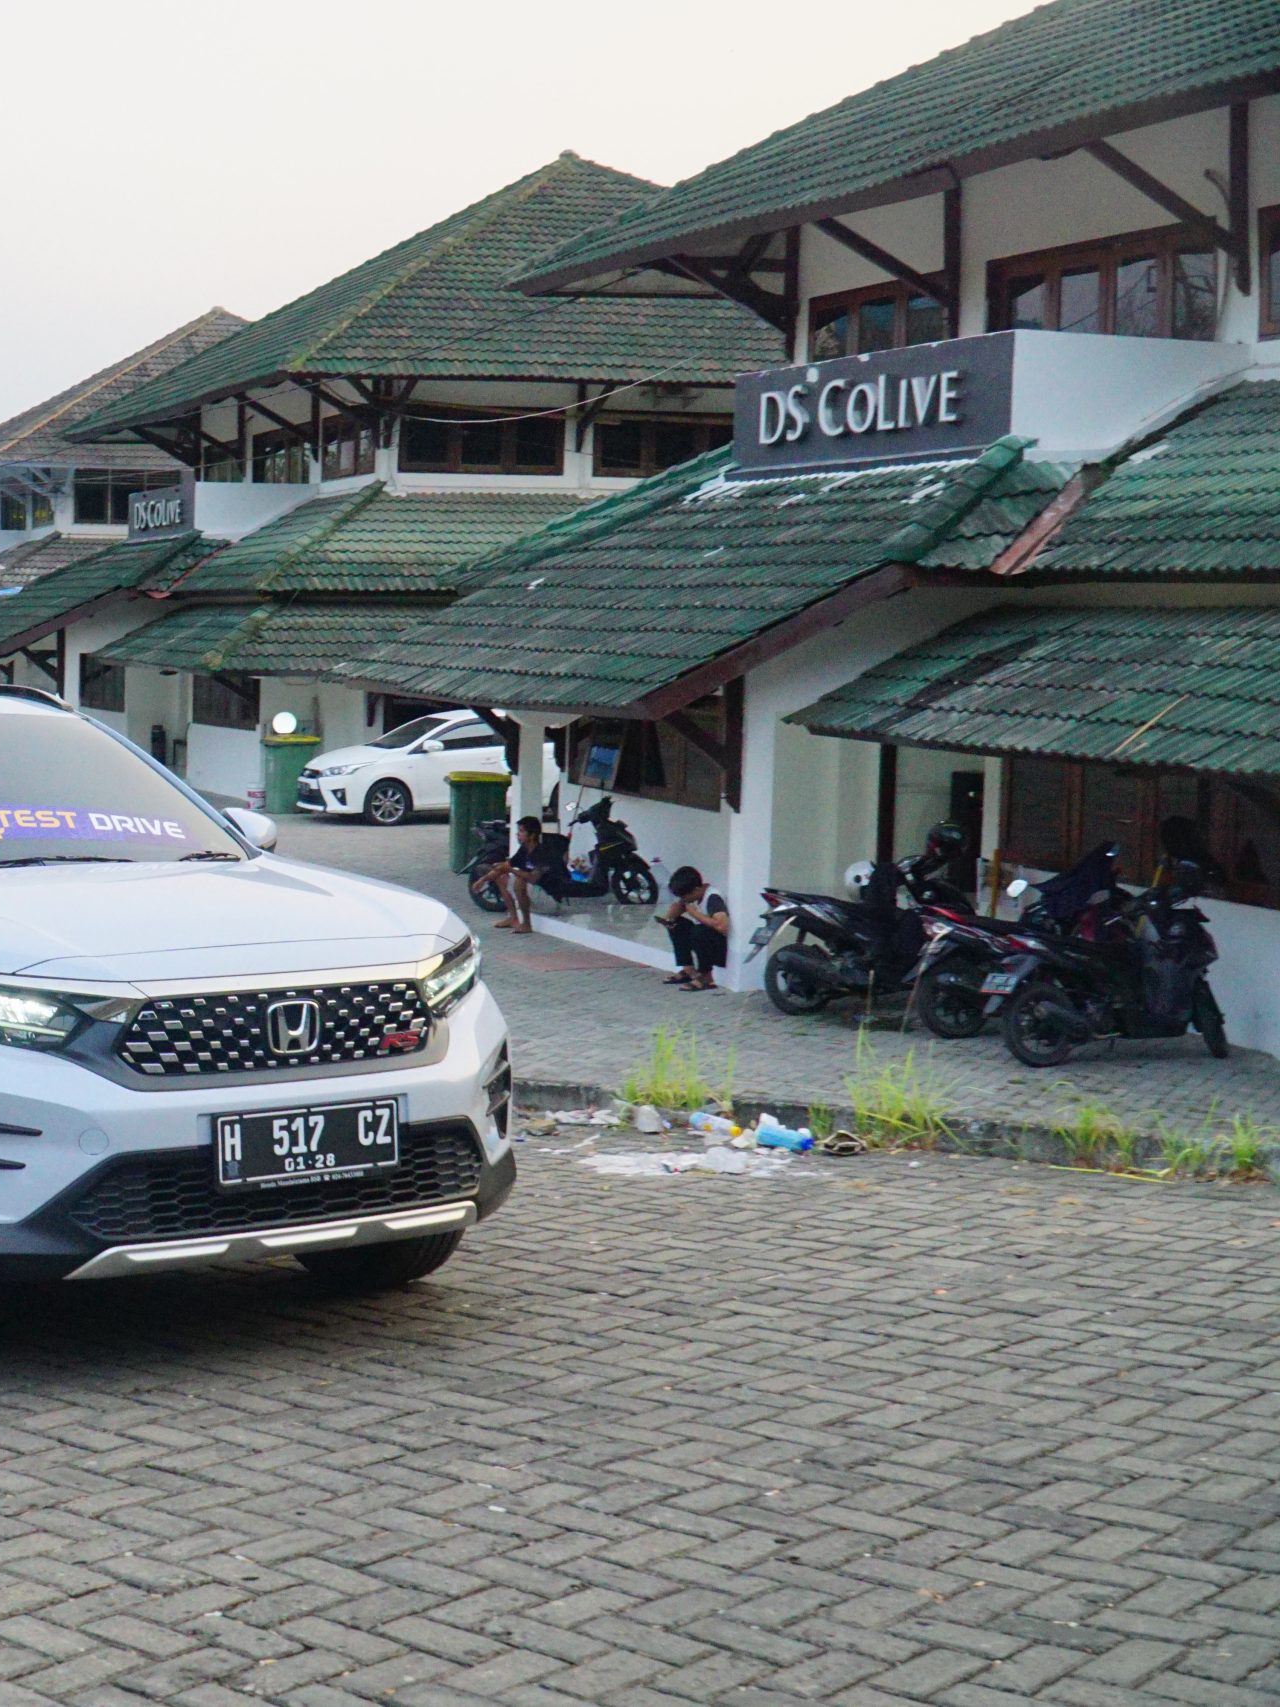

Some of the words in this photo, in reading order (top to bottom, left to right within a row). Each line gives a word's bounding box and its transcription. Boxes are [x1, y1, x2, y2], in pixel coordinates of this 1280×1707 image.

[758, 384, 809, 445] DS
[818, 370, 959, 437] COLIVE
[133, 501, 146, 529] DS
[88, 812, 186, 839] DRIVE
[223, 1123, 242, 1162] H
[272, 1114, 326, 1156] 517
[357, 1107, 392, 1147] CZ
